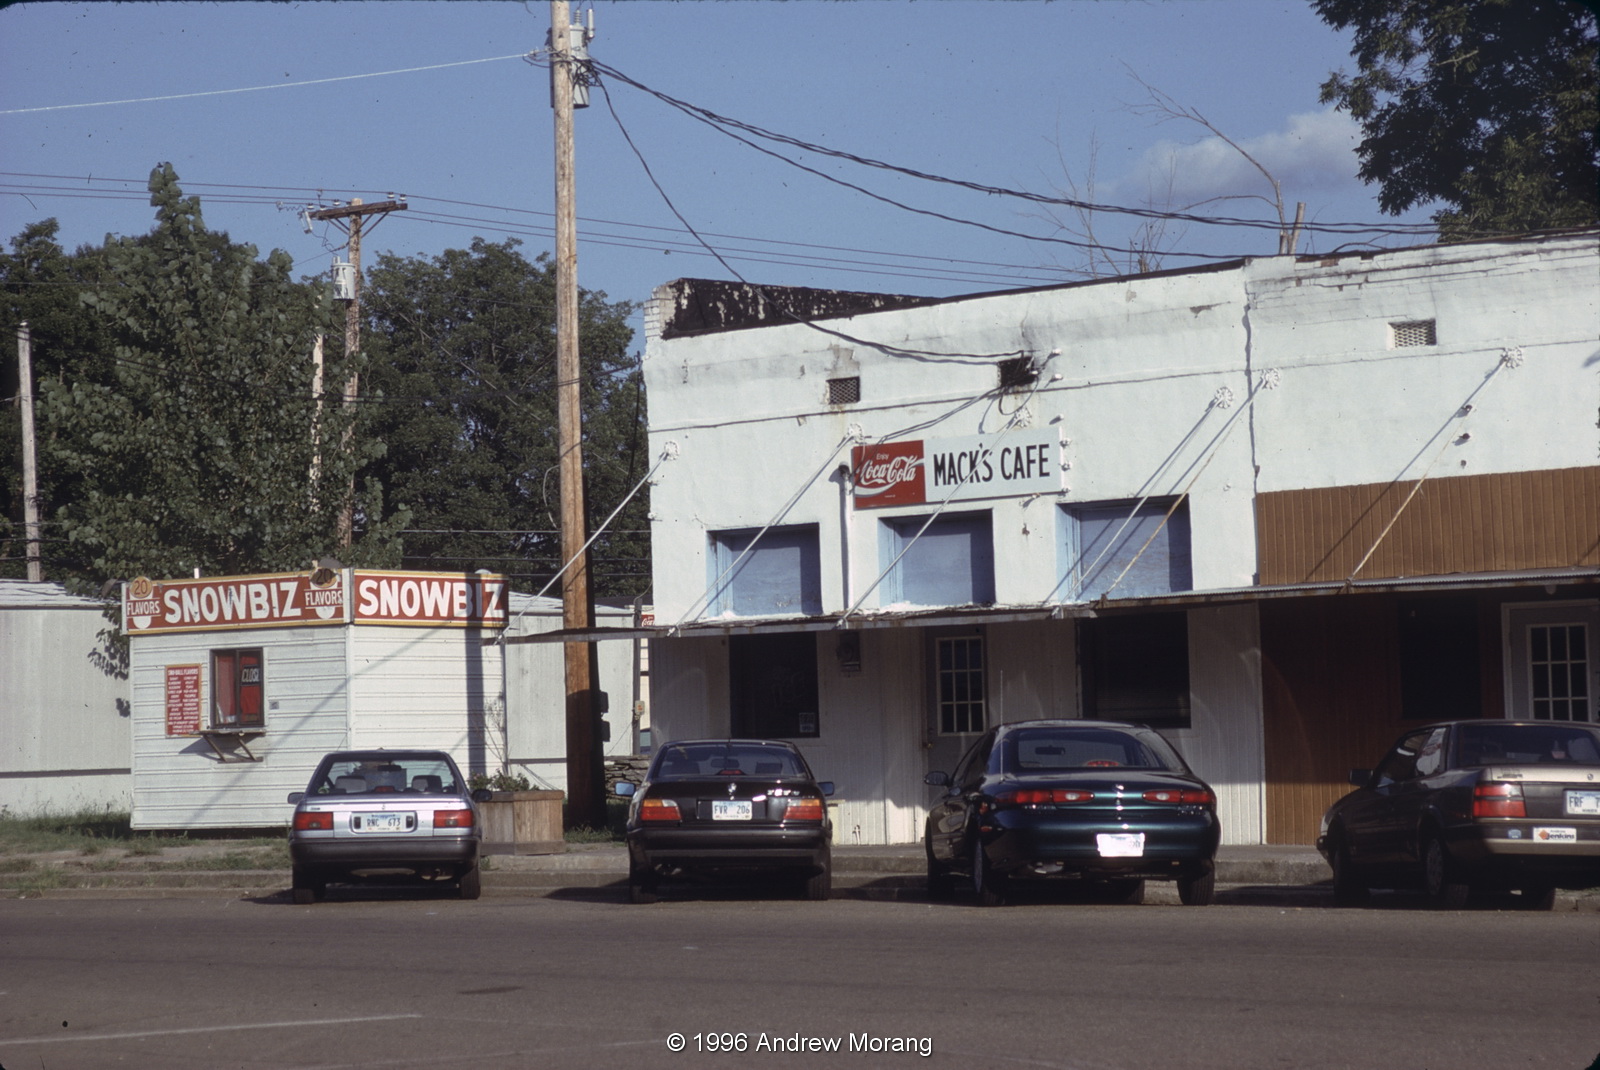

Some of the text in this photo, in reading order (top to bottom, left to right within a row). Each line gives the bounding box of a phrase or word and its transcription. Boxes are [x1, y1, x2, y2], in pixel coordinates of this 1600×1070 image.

[860, 455, 918, 486] Coca-Cola
[933, 443, 1050, 487] MACK'S CAFE
[314, 568, 333, 586] 20
[133, 580, 148, 595] 20
[163, 581, 302, 624] SNOWBIZ
[304, 590, 343, 606] FLAVORS
[358, 579, 506, 618] SNOWBIZ
[126, 600, 161, 616] FLAVORS
[736, 804, 750, 814] 206
